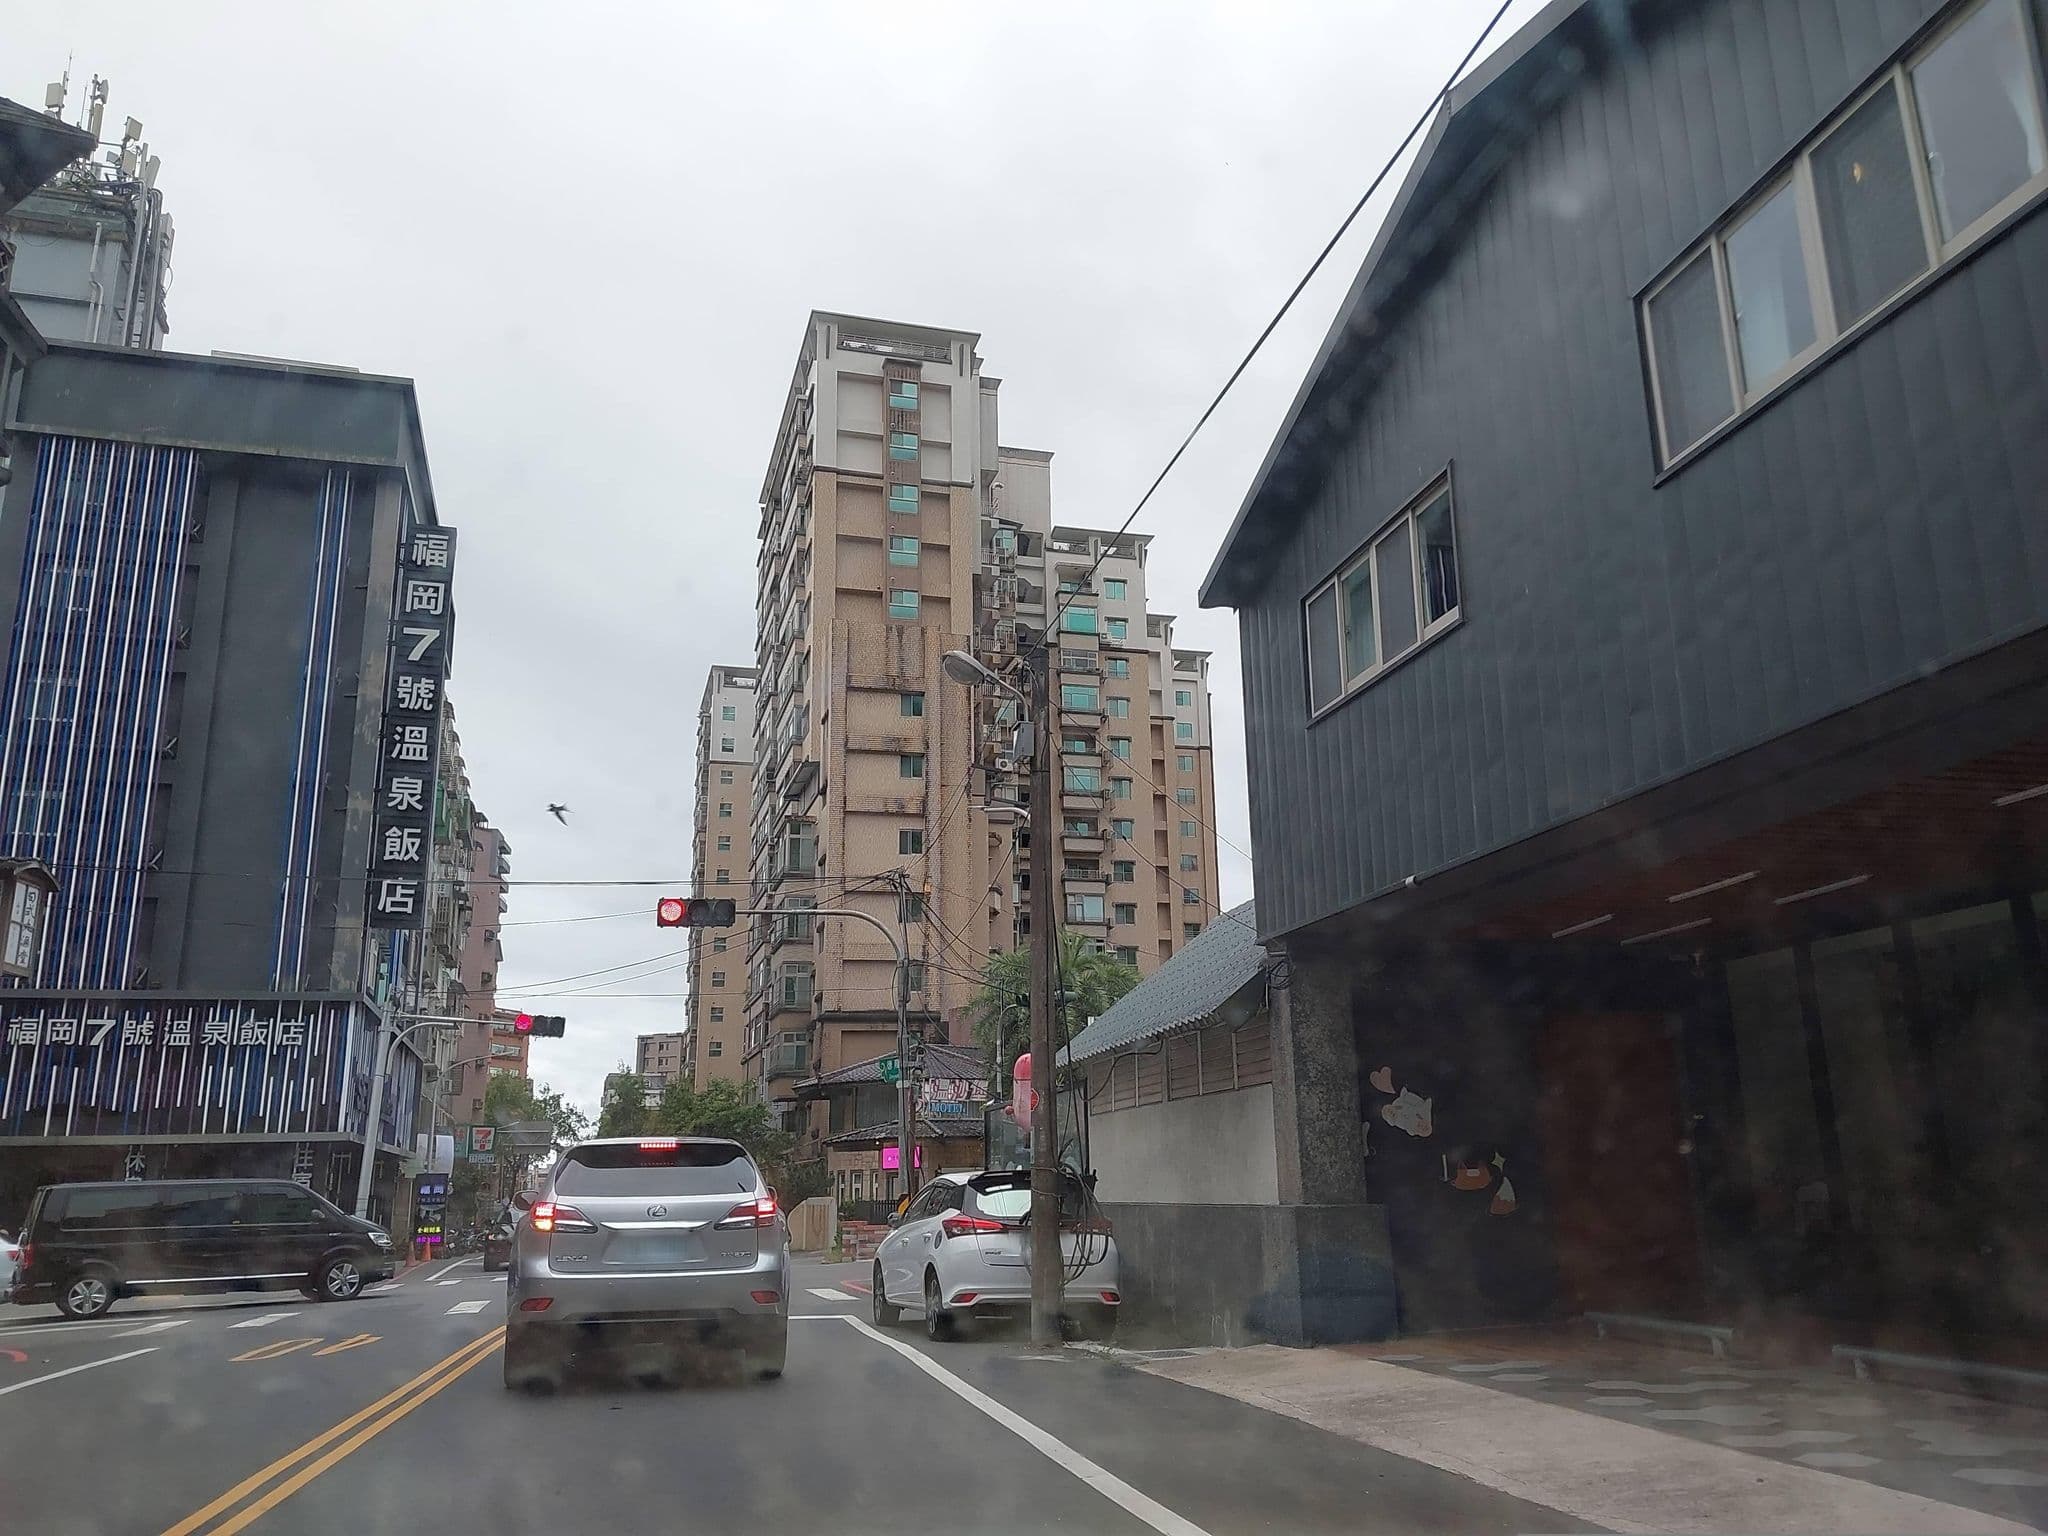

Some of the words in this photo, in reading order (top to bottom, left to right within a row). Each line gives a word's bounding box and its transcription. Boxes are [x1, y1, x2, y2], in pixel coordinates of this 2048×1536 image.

[377, 532, 449, 915] 福岡7號溫泉飯店
[6, 1016, 306, 1047] 福岡7號溫泉飯店
